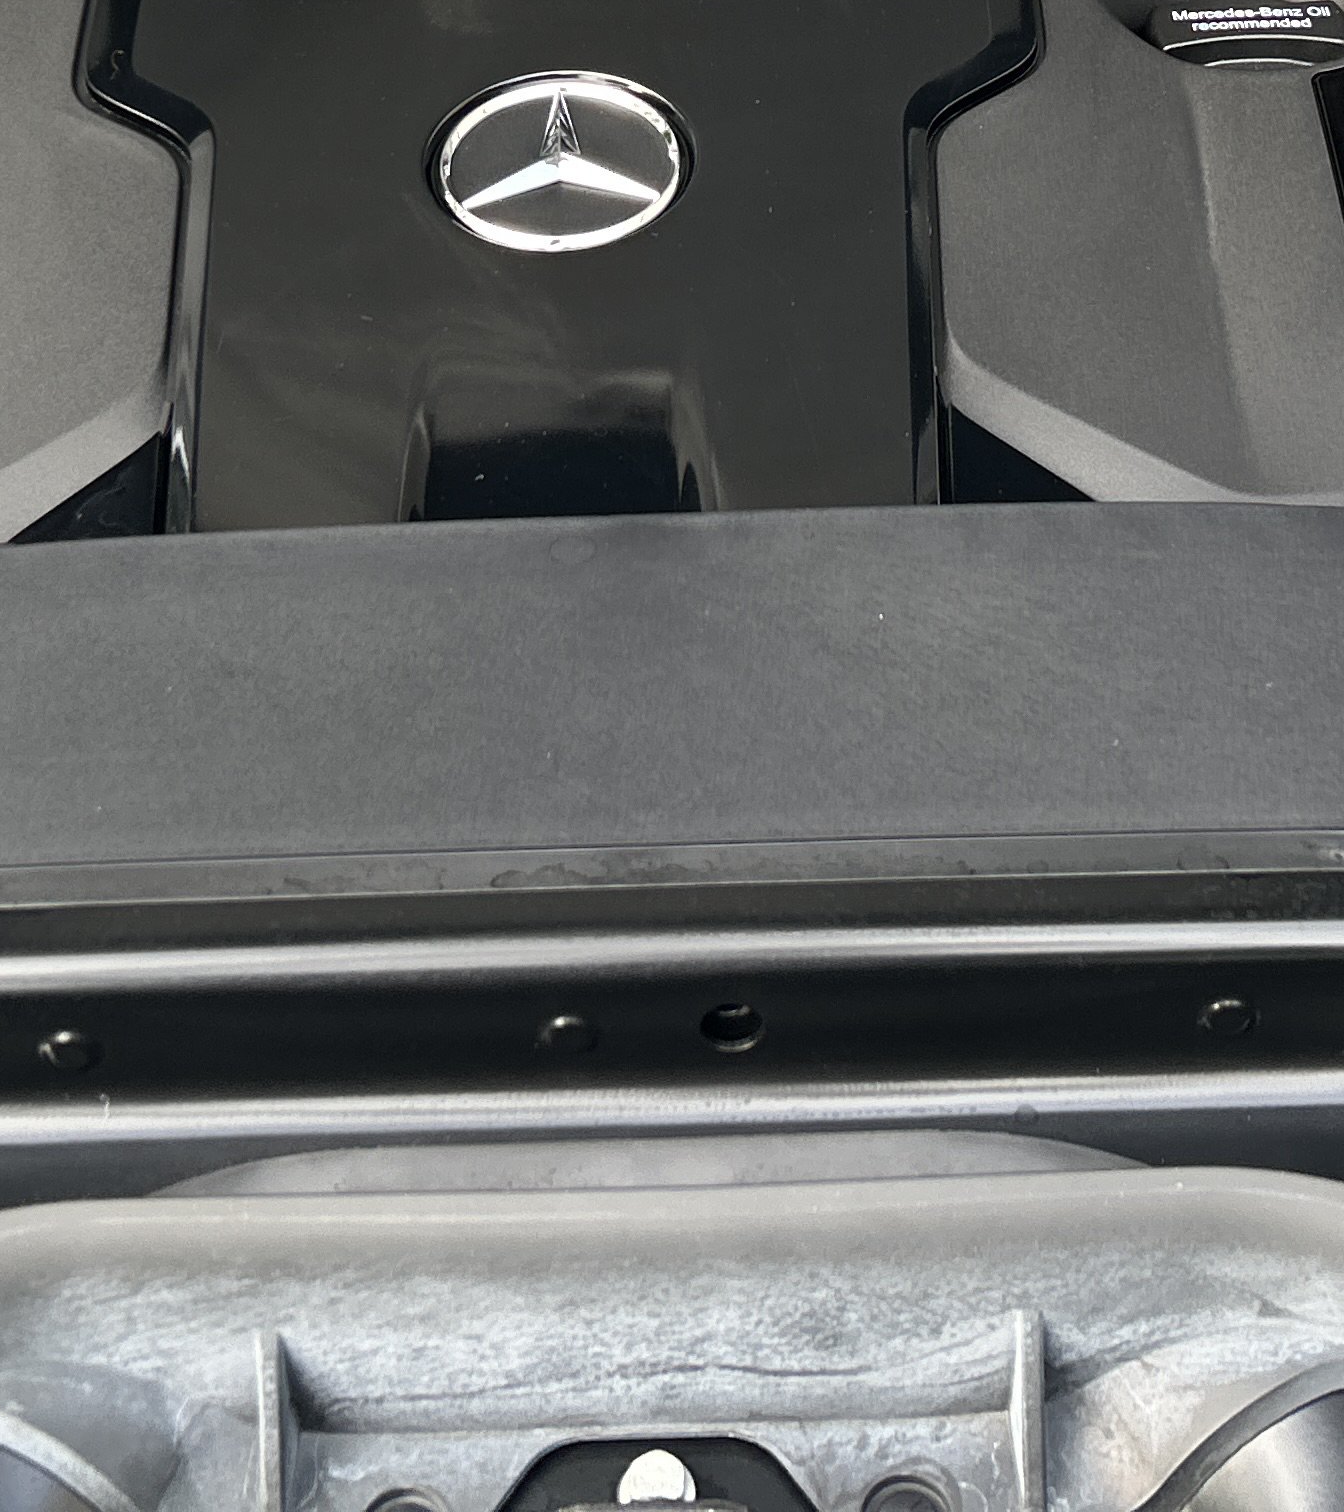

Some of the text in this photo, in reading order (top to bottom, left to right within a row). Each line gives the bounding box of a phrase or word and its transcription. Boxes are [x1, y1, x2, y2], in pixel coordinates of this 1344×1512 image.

[1171, 5, 1331, 21] Mercedes-Benz Oil
[1191, 17, 1313, 32] recommended
